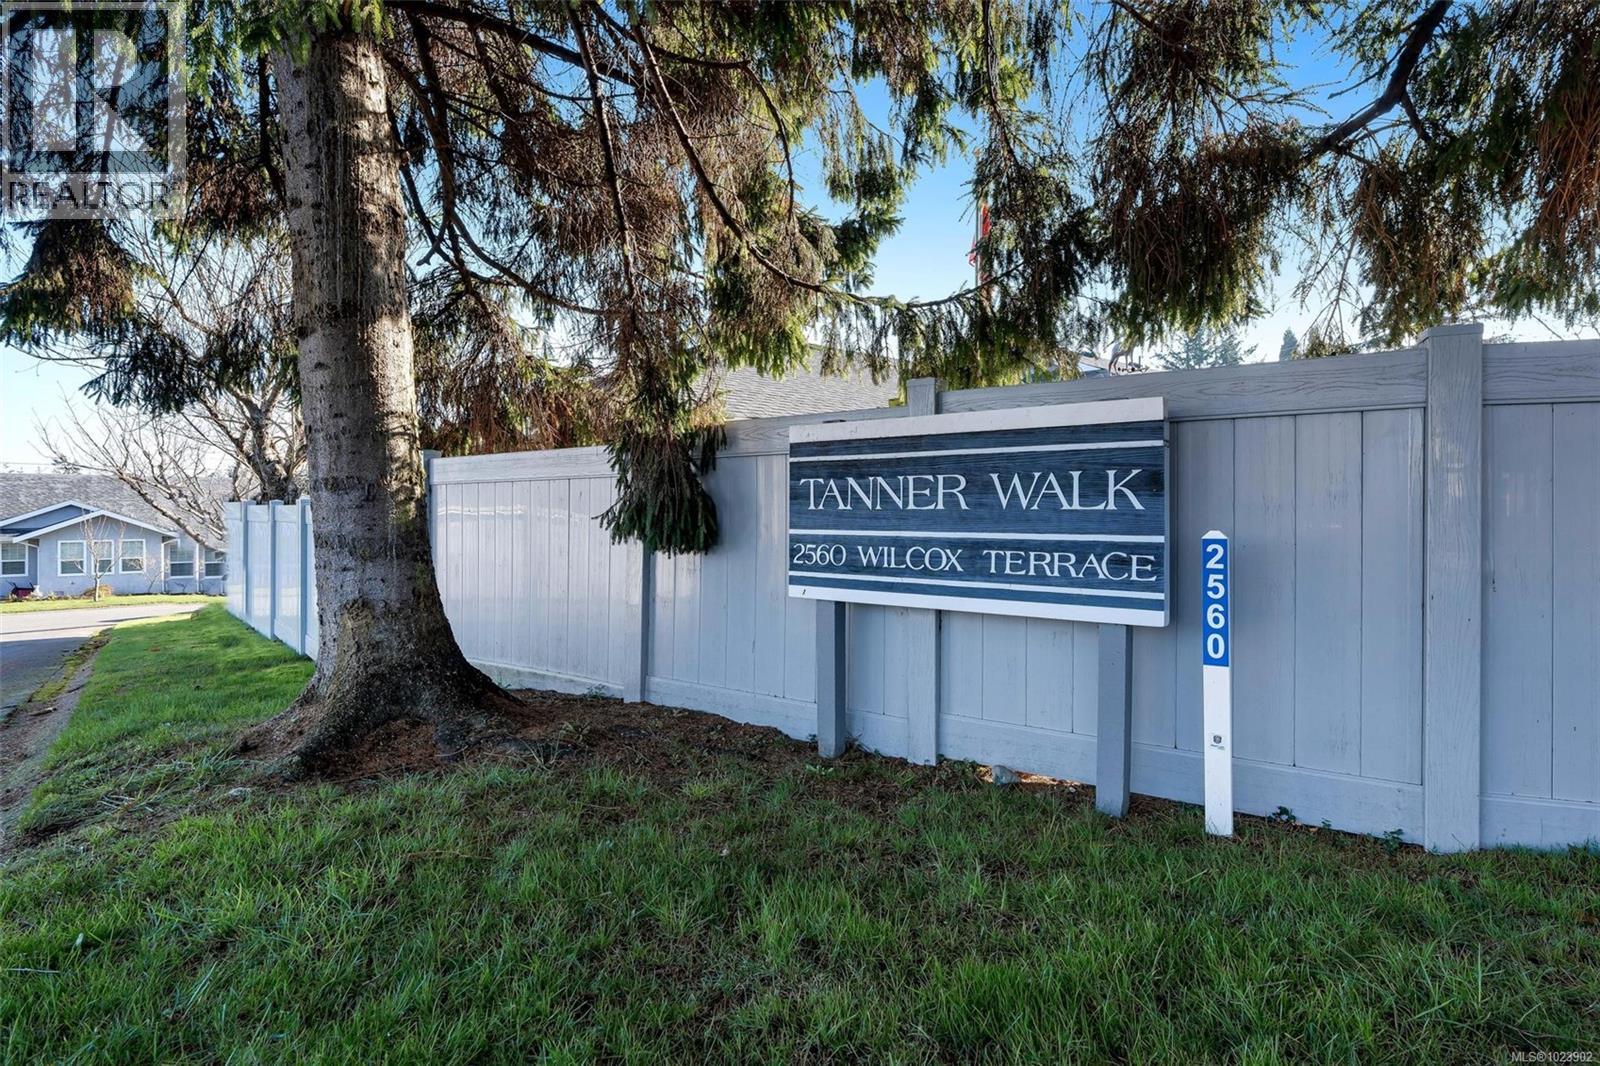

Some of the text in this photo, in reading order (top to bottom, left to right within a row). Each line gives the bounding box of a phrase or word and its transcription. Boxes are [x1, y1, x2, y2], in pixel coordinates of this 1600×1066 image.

[800, 468, 1146, 511] TANNER WALK
[792, 543, 1157, 582] 2560 WILCOX TERRACE
[1205, 543, 1226, 660] 2560
